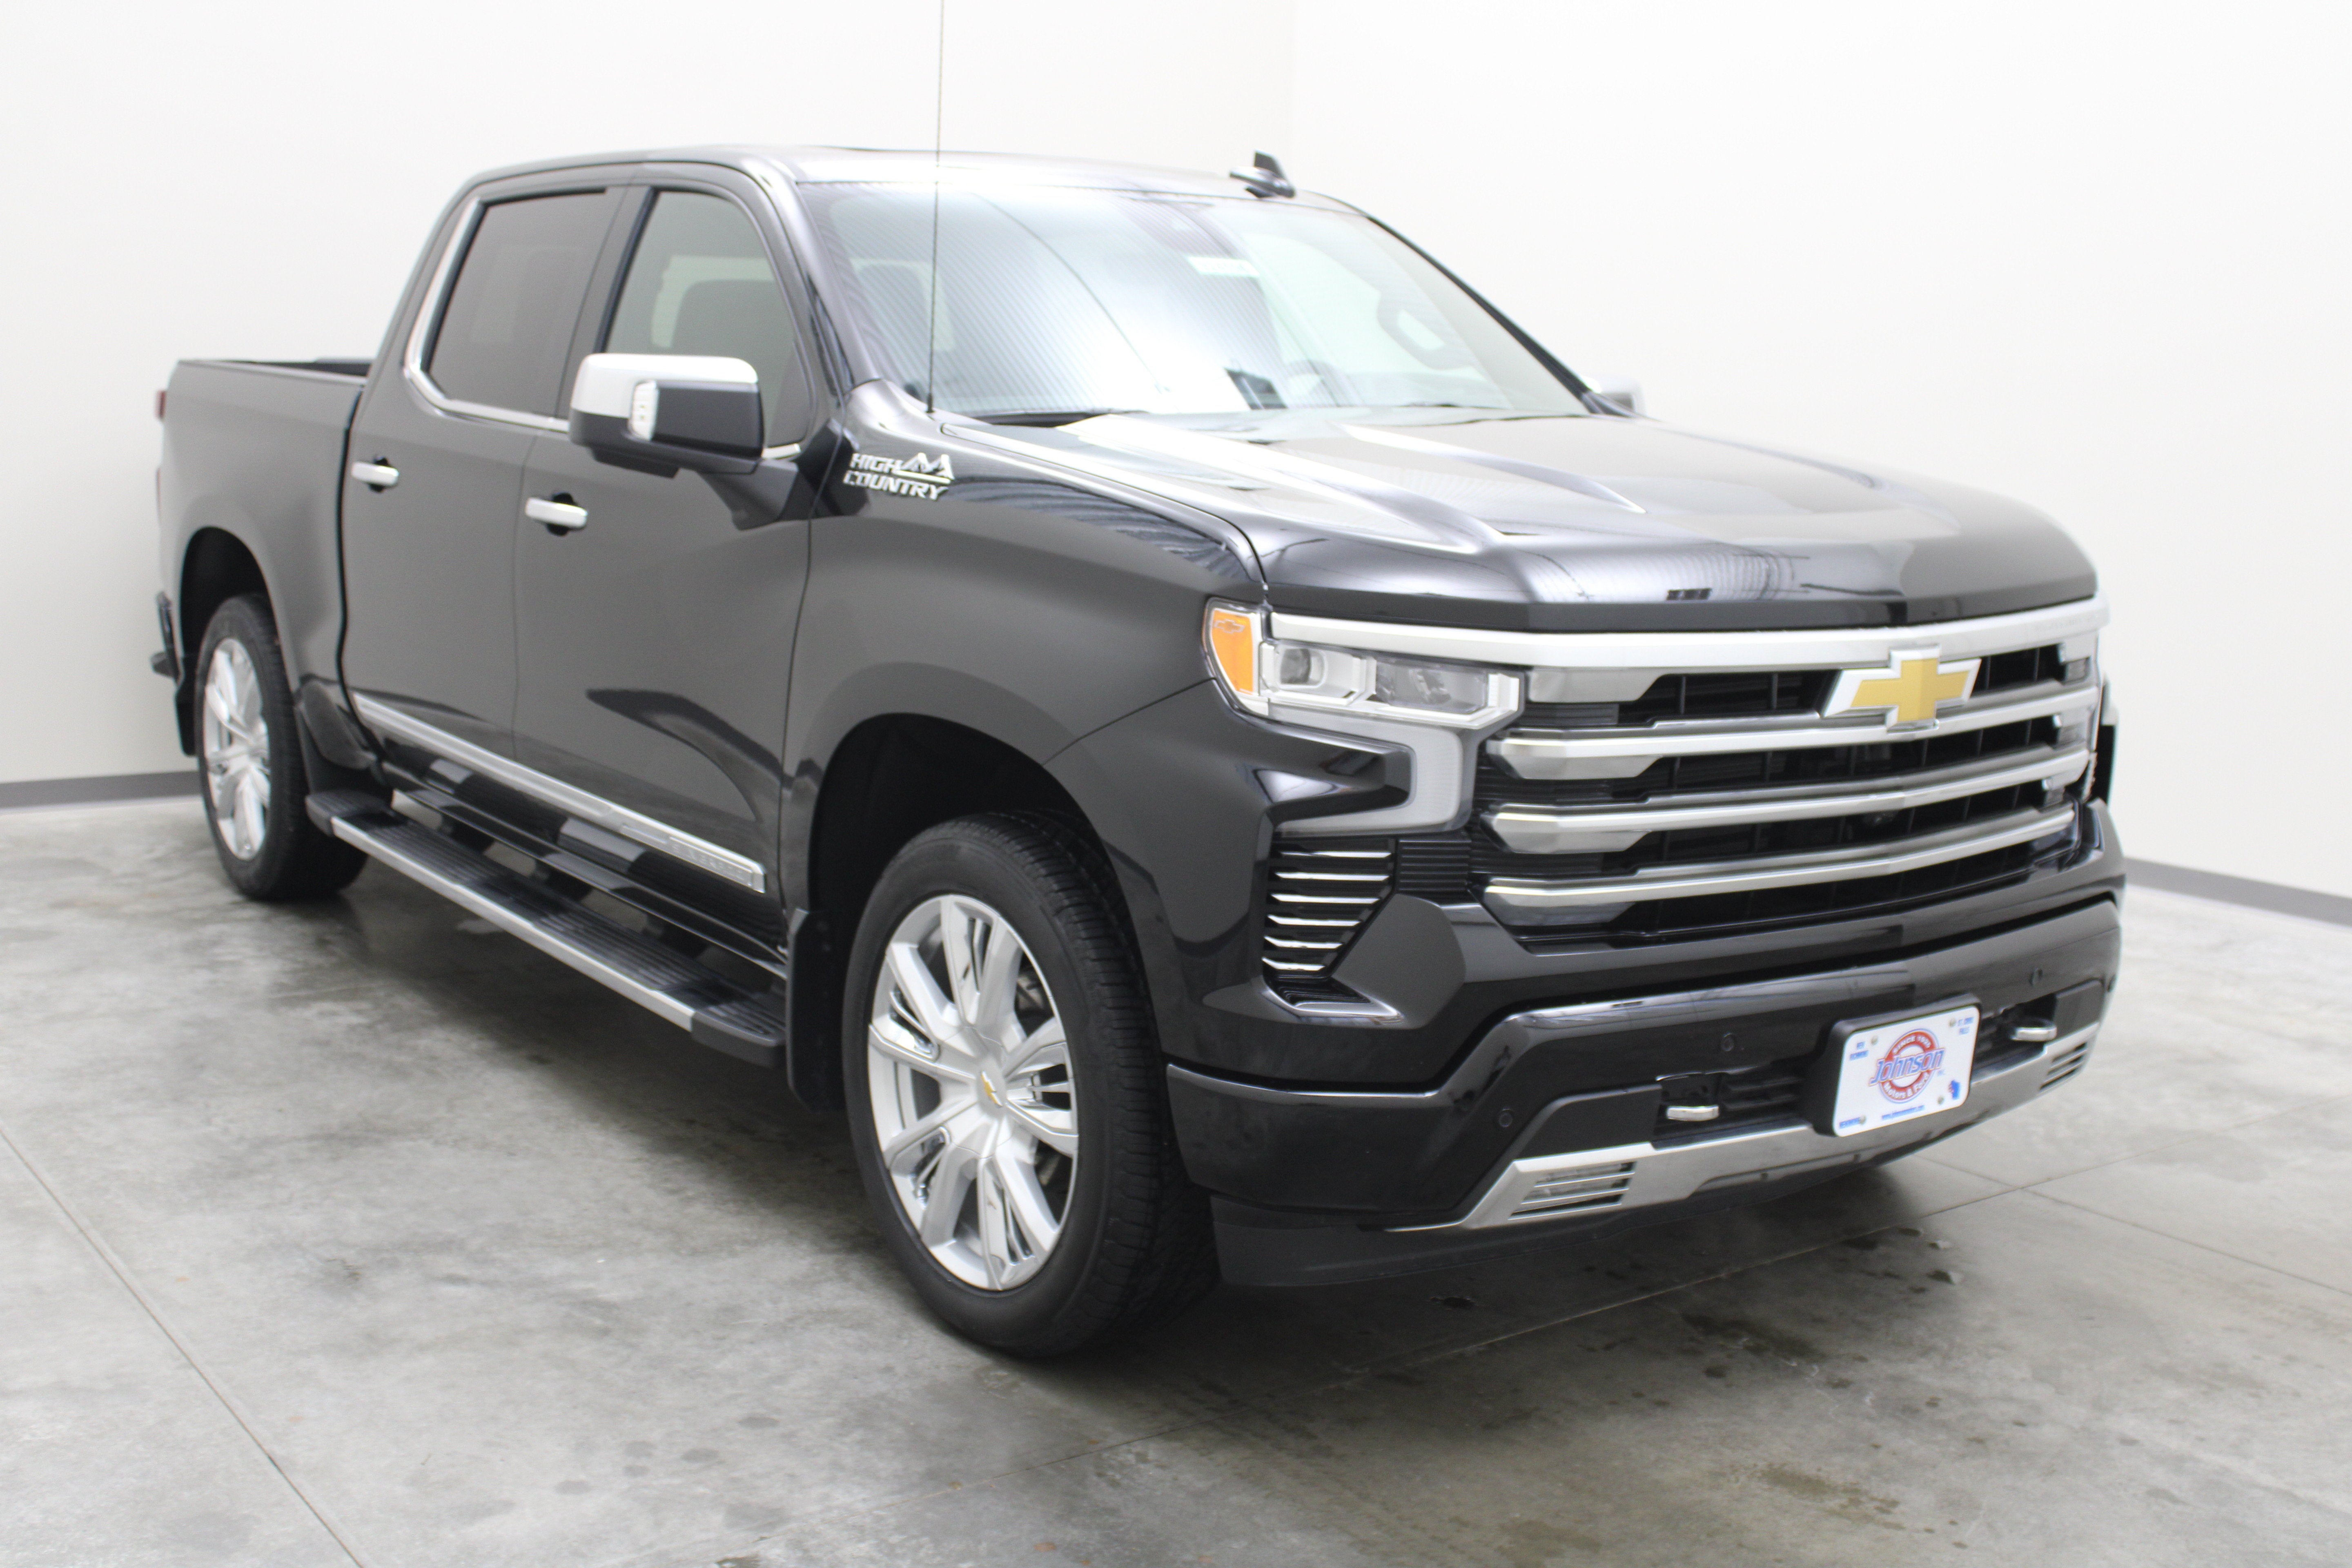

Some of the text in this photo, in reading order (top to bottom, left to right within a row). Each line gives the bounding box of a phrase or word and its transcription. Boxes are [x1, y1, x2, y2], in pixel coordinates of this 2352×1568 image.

[849, 453, 903, 474] HIGH
[843, 470, 948, 501] COUNTRY
[1892, 1036, 1916, 1054] SINCE
[1869, 1048, 1944, 1085] Johnson
[1883, 1081, 1906, 1098] Motors
